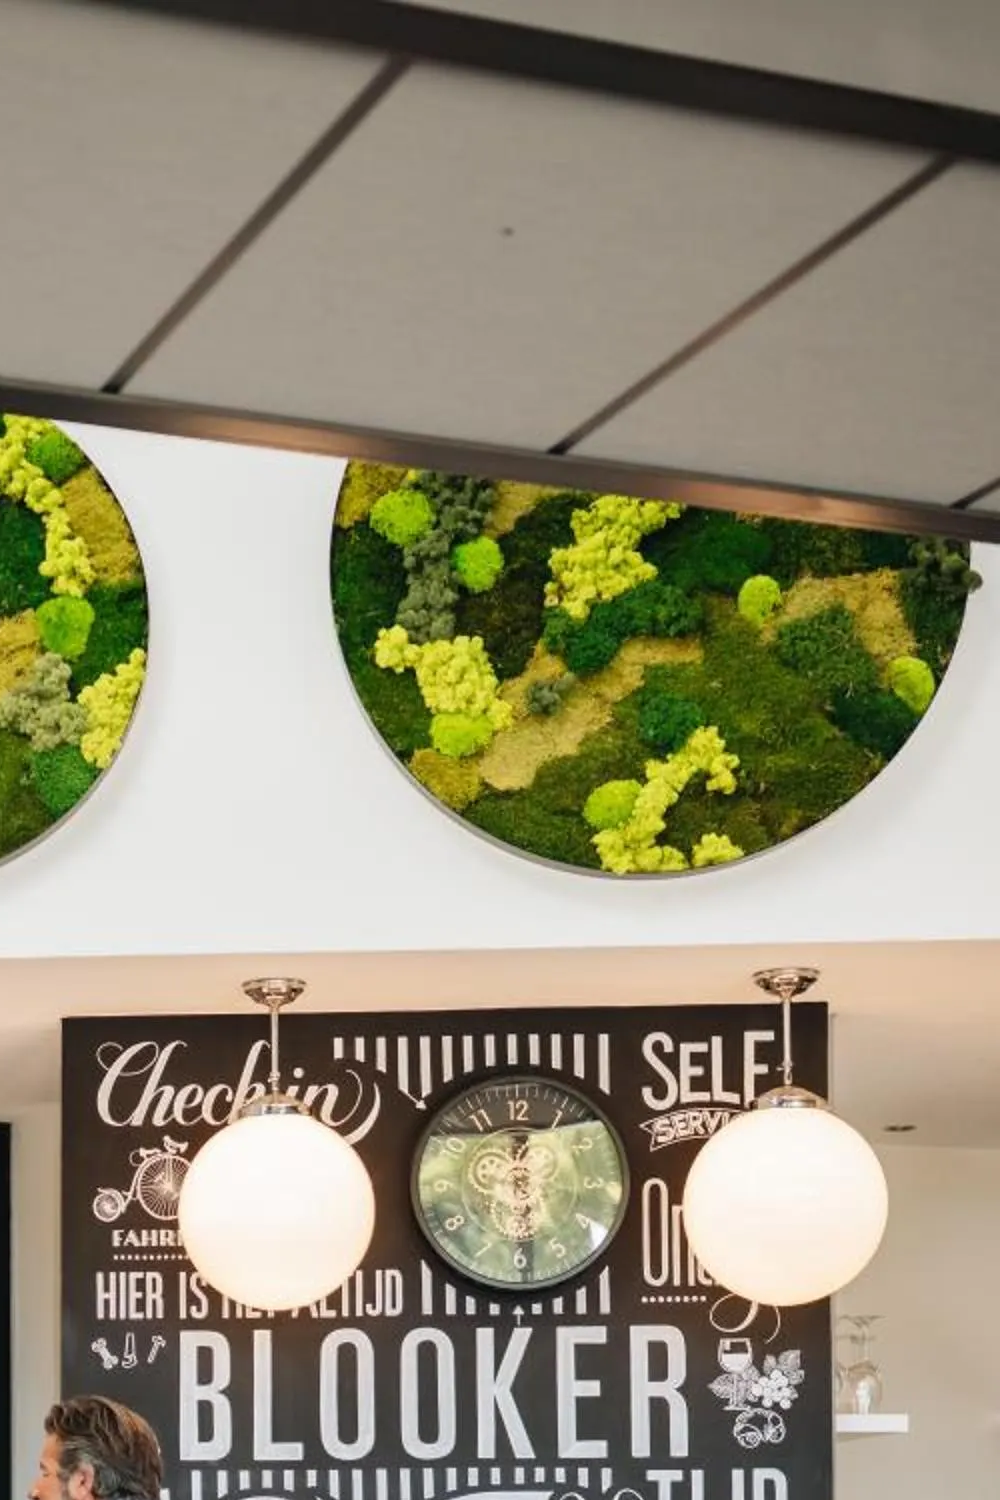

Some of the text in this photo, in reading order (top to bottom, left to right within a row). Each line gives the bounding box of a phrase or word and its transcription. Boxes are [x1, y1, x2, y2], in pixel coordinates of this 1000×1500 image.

[641, 1030, 775, 1110] SELF
[470, 1109, 493, 1132] 11
[508, 1101, 529, 1121] 12
[552, 1110, 563, 1129] 1
[434, 1180, 454, 1192] 9
[584, 1177, 603, 1189] 3
[445, 1215, 465, 1231] 8
[112, 1230, 184, 1247] FAHR
[549, 1239, 566, 1258] 5
[513, 1248, 527, 1269] 6
[96, 1271, 164, 1320] HIER
[179, 1271, 208, 1319] IS
[179, 1326, 689, 1461] BLOOKER
